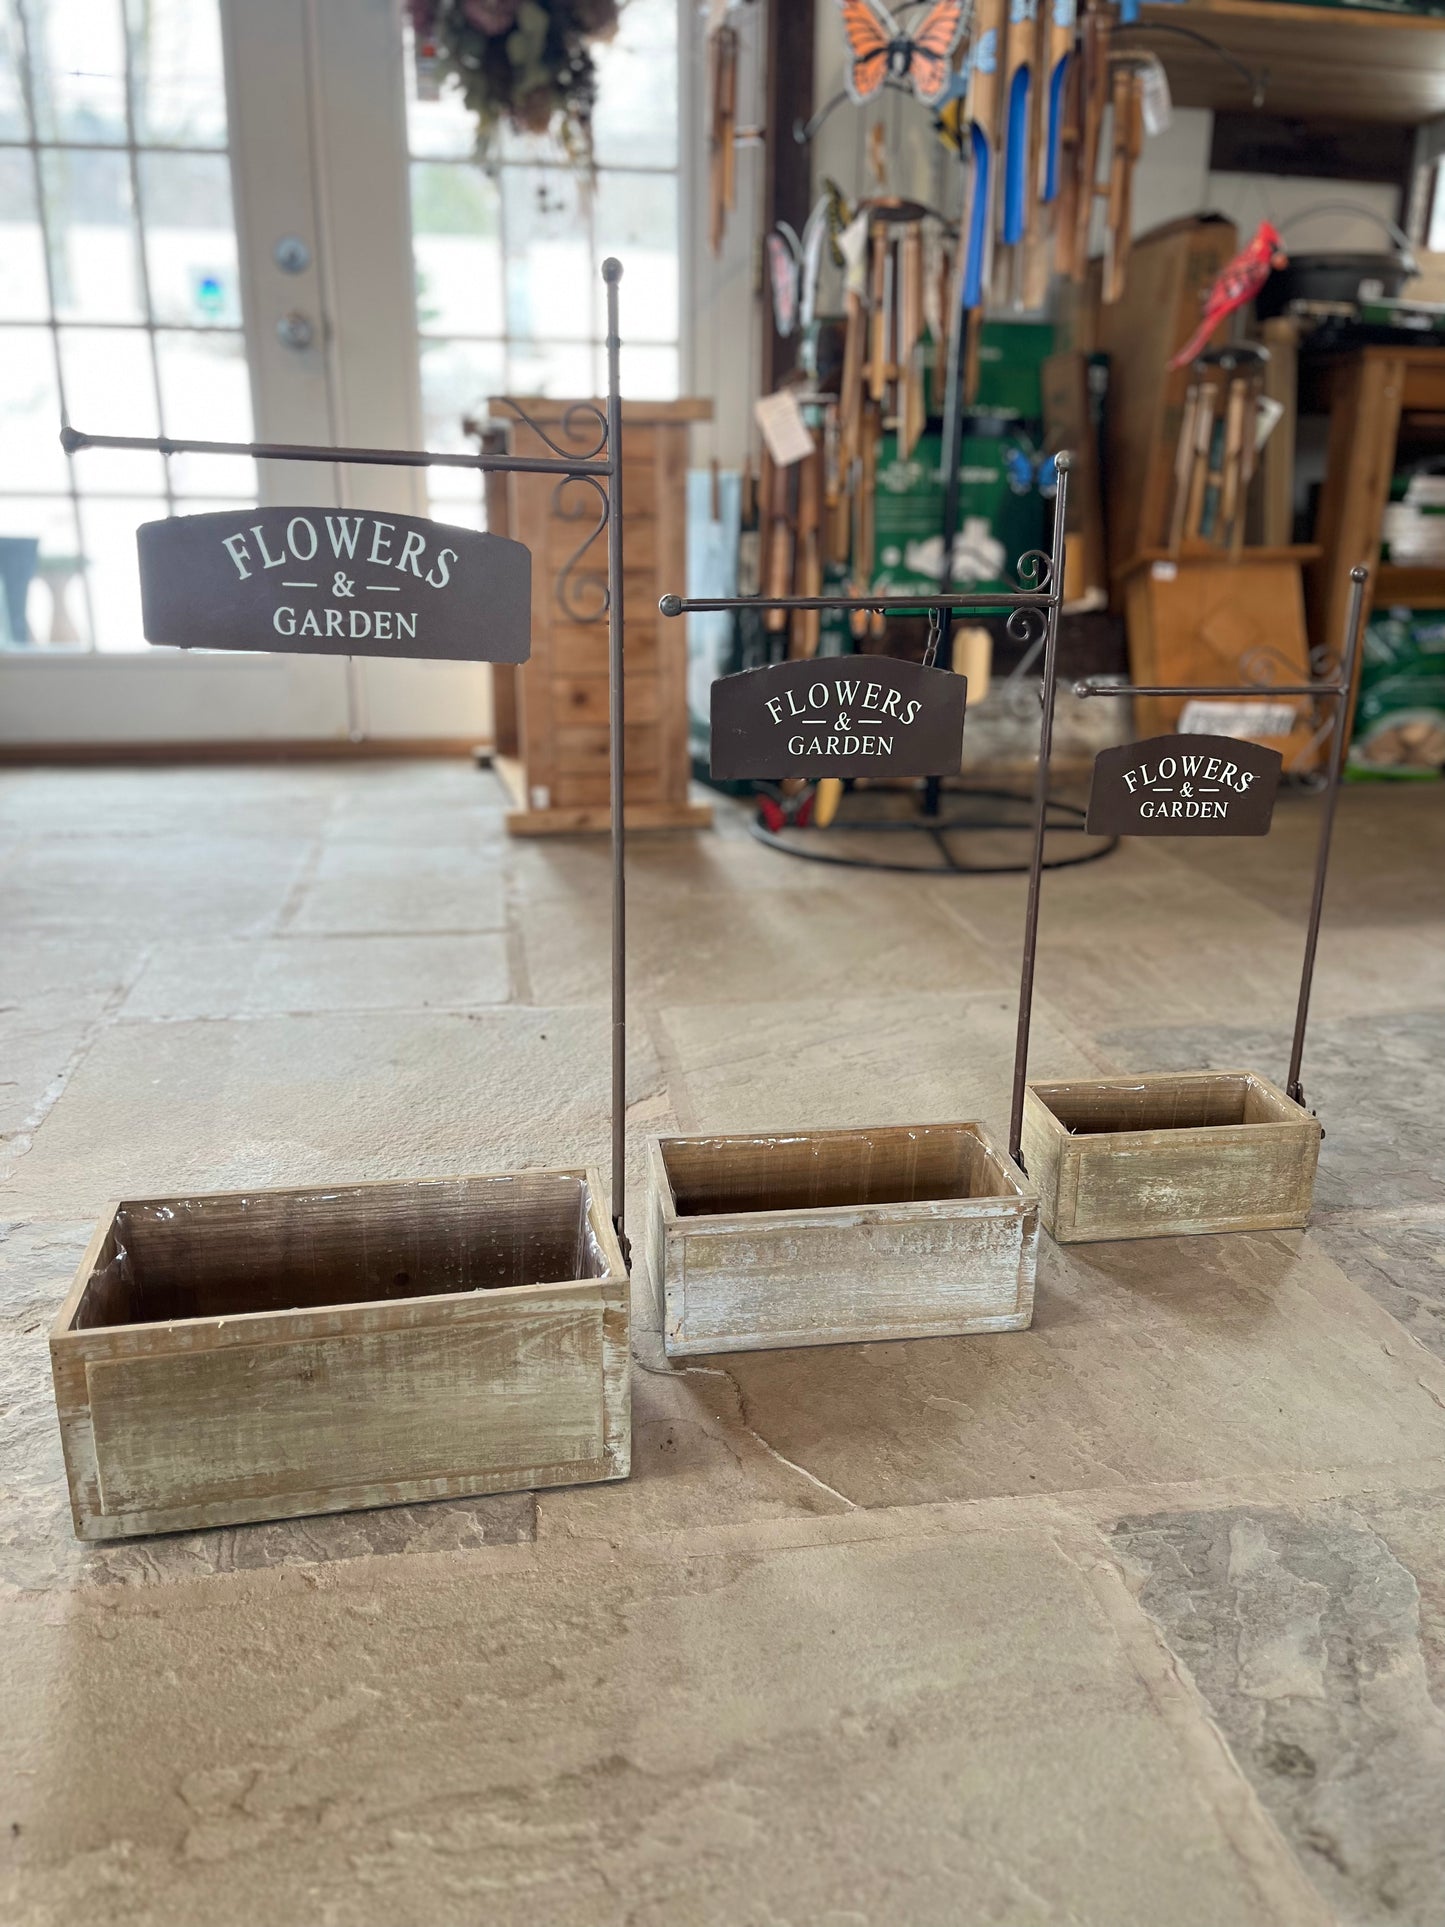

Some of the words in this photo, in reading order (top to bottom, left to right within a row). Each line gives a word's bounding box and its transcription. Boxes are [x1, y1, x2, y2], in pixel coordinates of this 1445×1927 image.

[221, 516, 459, 589] FLOWERS
[332, 571, 355, 598] &
[273, 606, 419, 640] GARDEN
[764, 680, 923, 725] FLOWERS
[833, 711, 852, 731] &
[787, 735, 894, 756] GARDEN
[1121, 755, 1255, 794] FLOWERS
[1139, 801, 1229, 819] GARDEN
